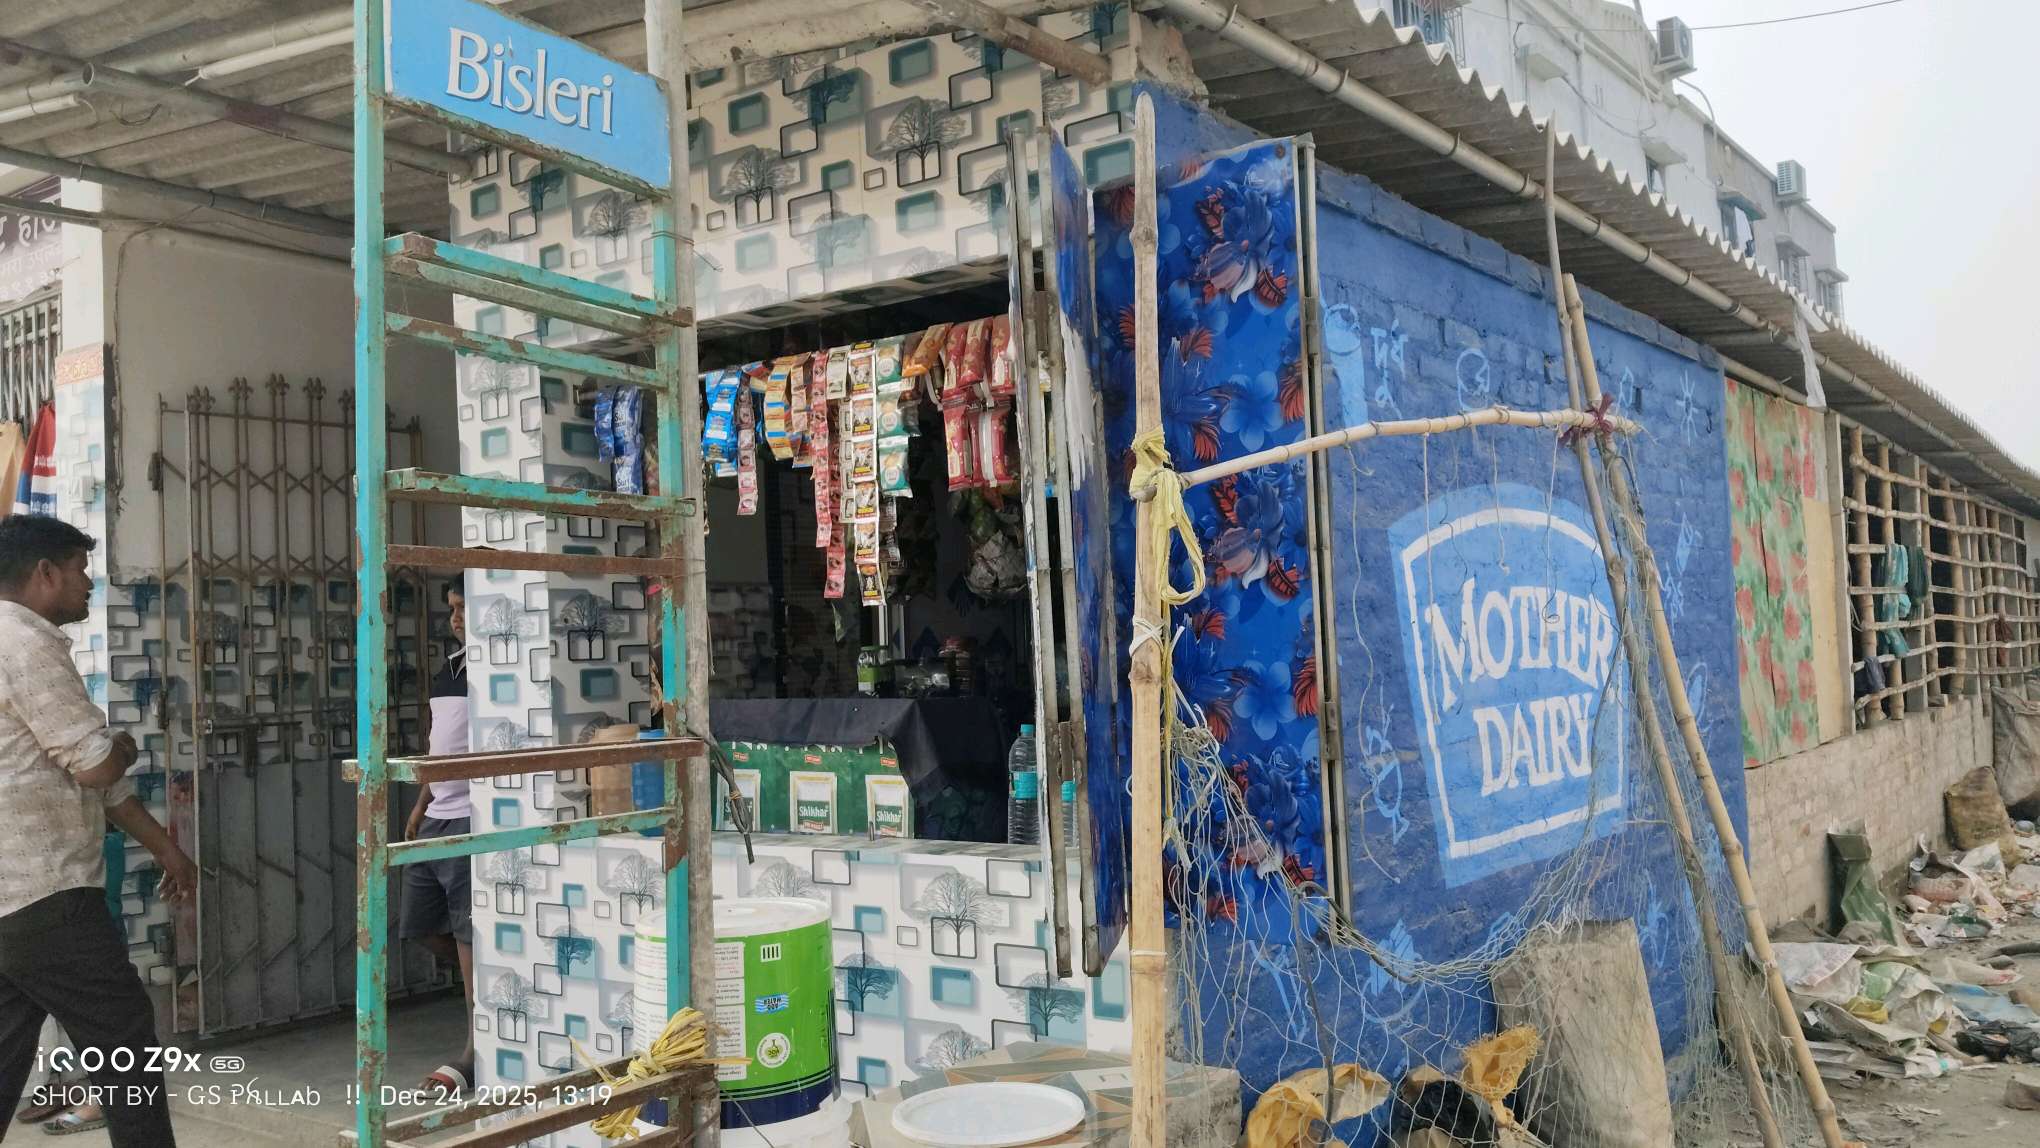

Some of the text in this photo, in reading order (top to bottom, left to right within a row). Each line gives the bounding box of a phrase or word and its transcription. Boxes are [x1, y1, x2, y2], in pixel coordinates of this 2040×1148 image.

[446, 27, 614, 136] Bisleri
[1424, 577, 1616, 712] MOTHER
[1473, 692, 1594, 797] DAIRY
[799, 805, 829, 818] Shikhar
